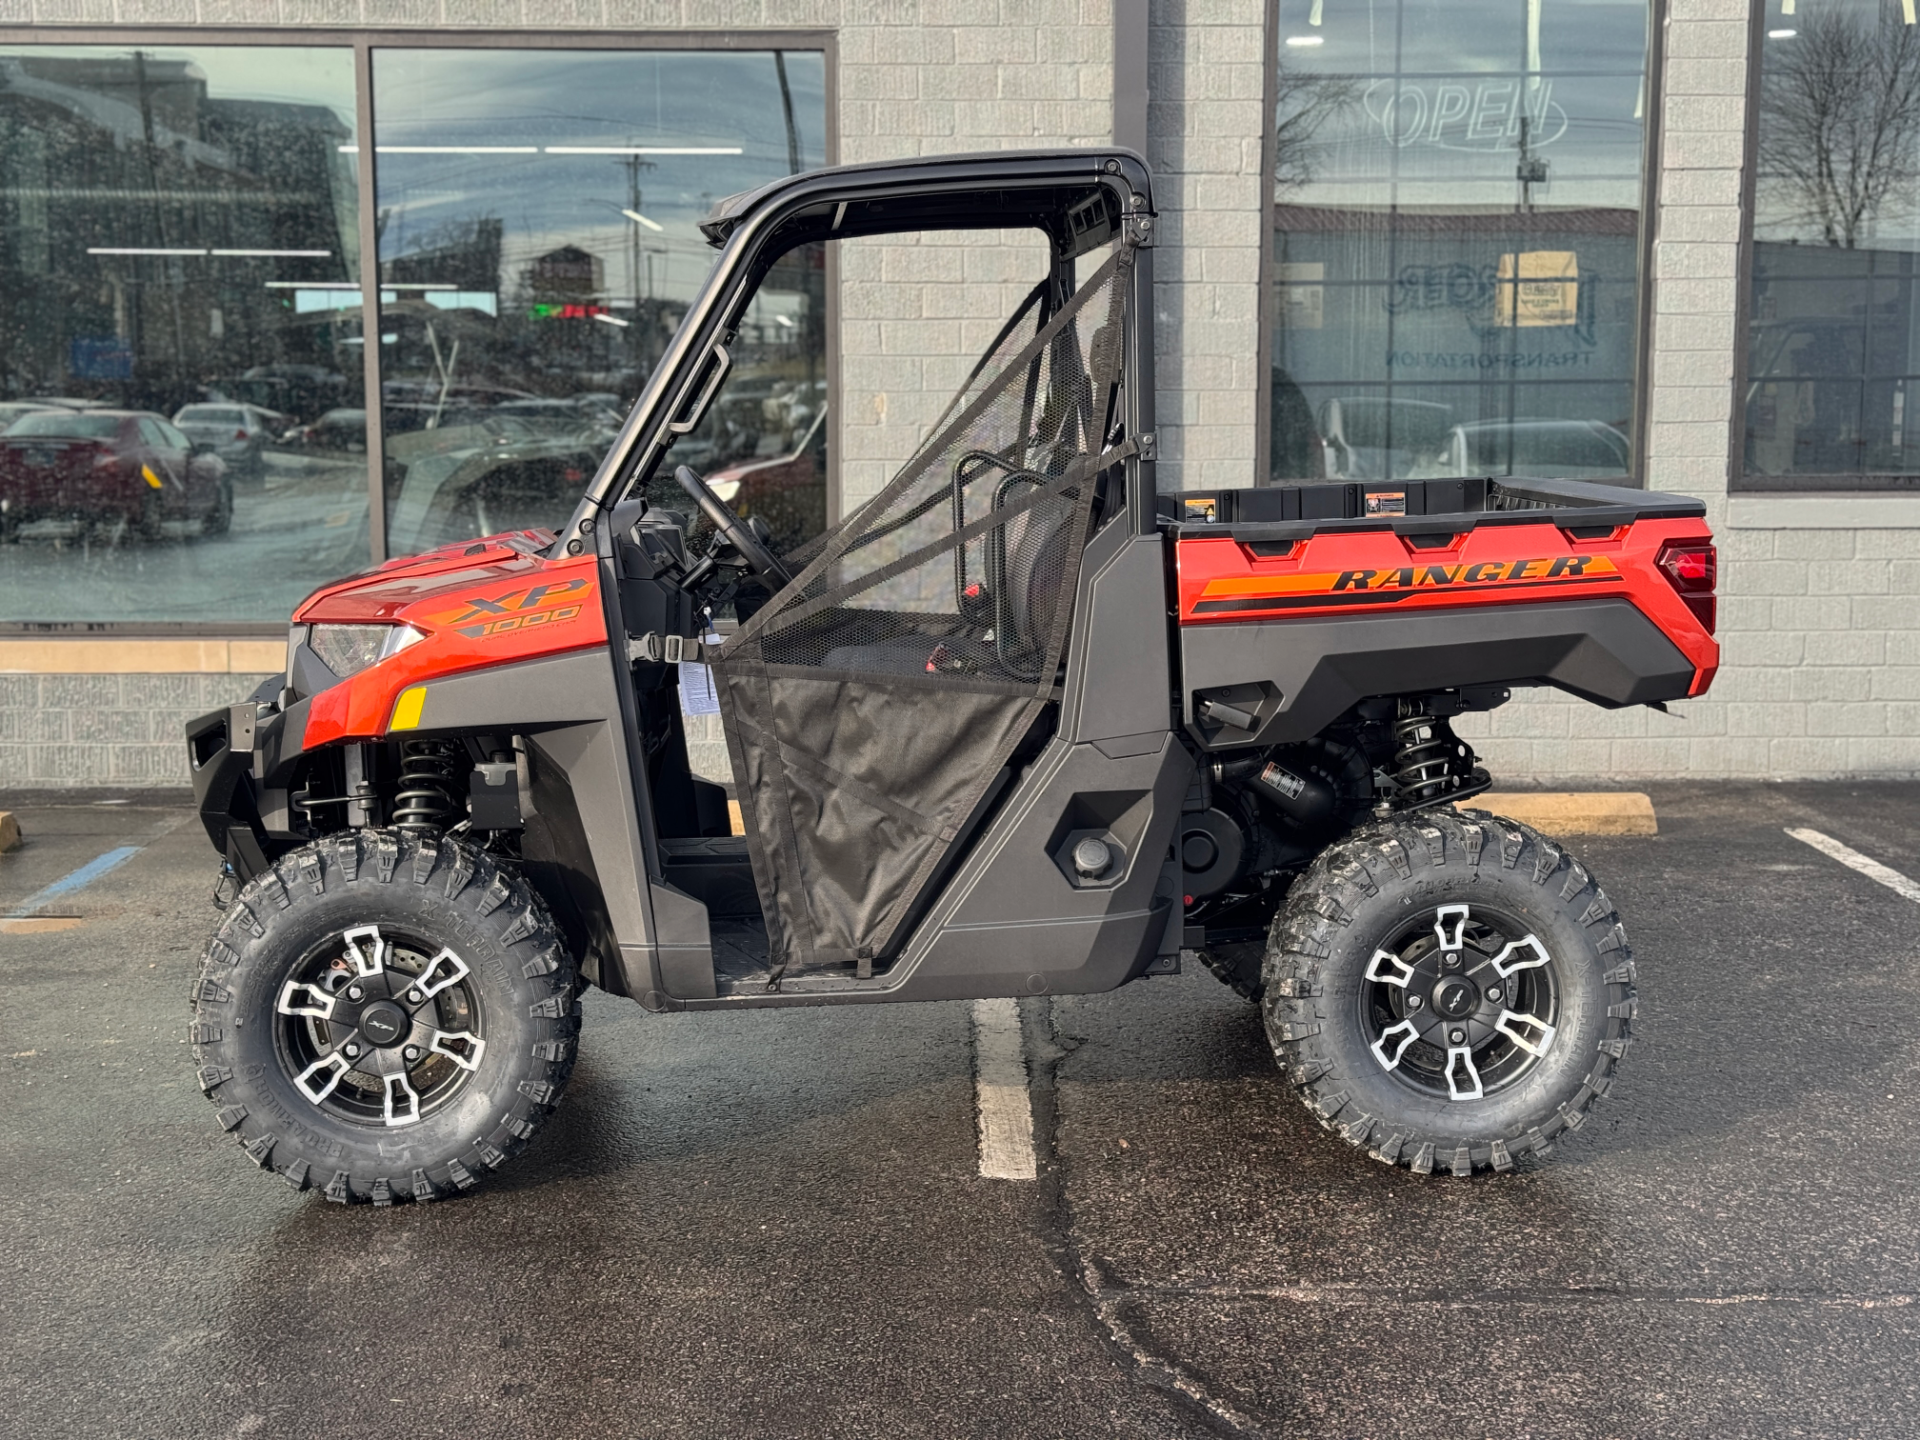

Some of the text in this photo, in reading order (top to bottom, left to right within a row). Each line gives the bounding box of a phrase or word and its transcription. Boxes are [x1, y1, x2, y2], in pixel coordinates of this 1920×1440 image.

[1383, 79, 1553, 148] OPEN
[1331, 556, 1592, 591] RANGER
[448, 578, 589, 625] XP
[482, 604, 583, 637] 1000
